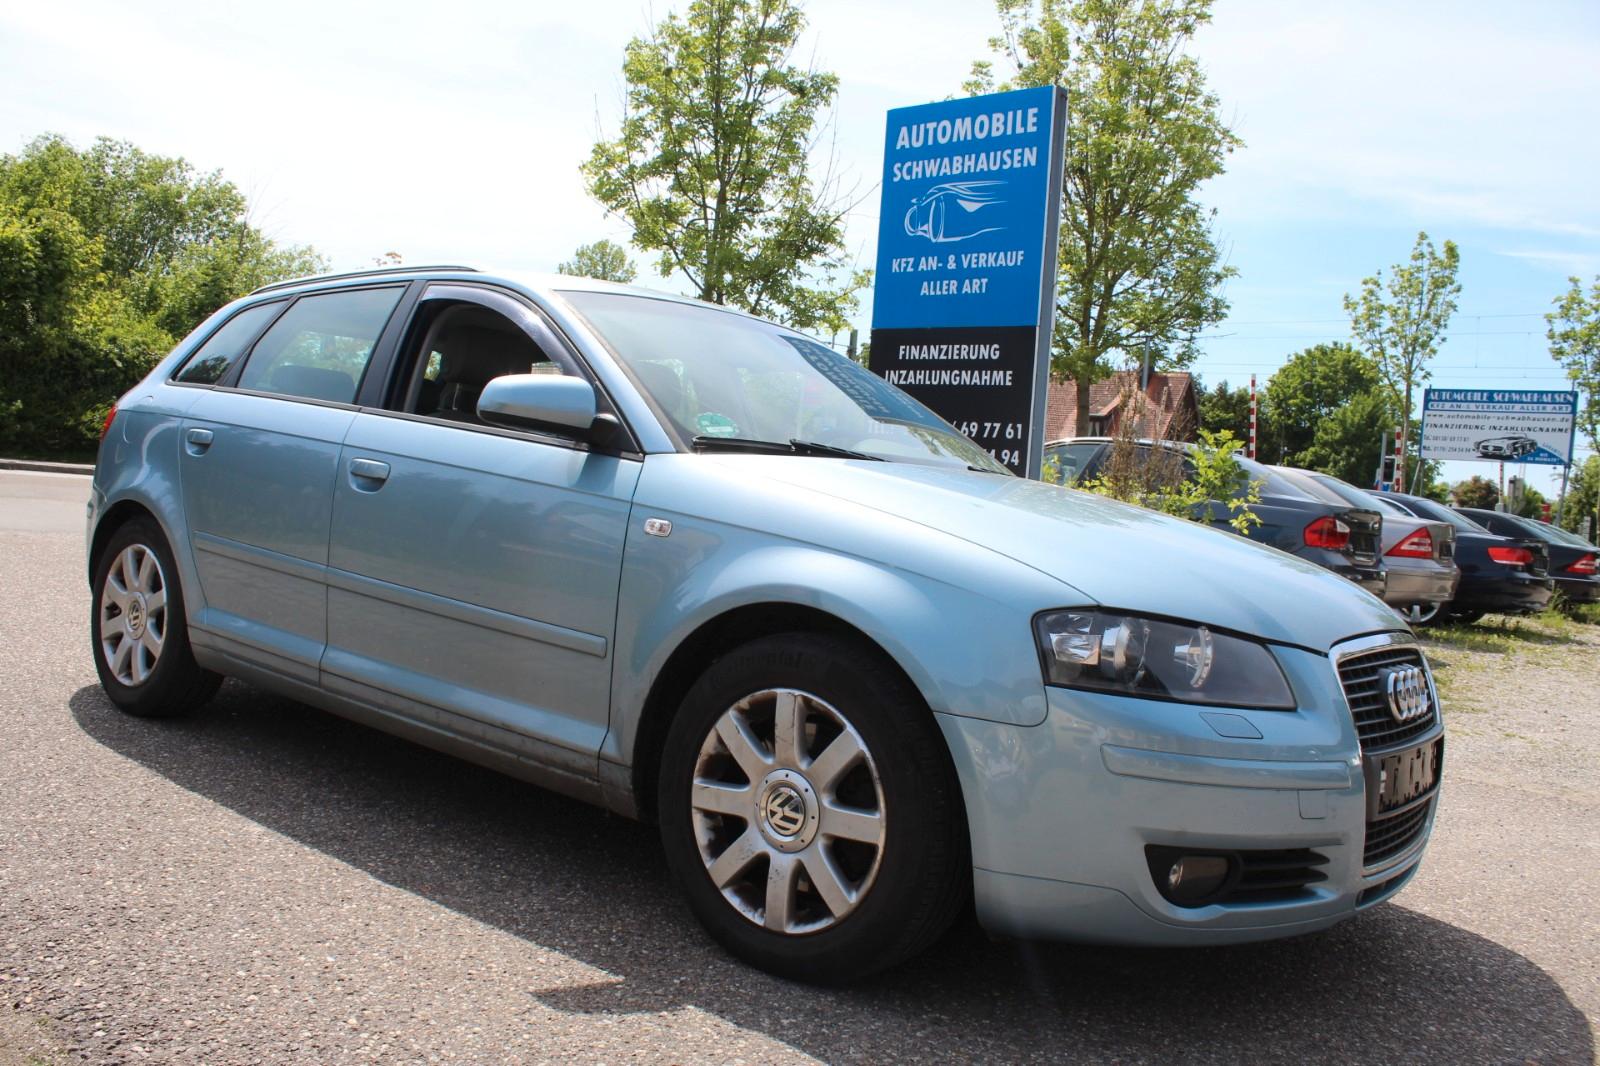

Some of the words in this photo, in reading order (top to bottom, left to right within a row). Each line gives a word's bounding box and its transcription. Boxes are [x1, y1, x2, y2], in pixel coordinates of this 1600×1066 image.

[895, 107, 1039, 150] AUTOMOBILE
[892, 146, 1038, 182] SCHWABHAUSEN
[892, 257, 915, 273] KFZ
[918, 256, 943, 272] AN-
[947, 256, 957, 270] &
[961, 250, 1025, 268] VERKAUF
[920, 280, 958, 296] ALLER
[962, 278, 988, 293] ART
[898, 343, 1001, 360] FINANZIERUNG
[884, 369, 1013, 386] INZAHLUNGNAHME
[1427, 391, 1489, 401] AUTOMOBILE
[960, 421, 979, 438] 69
[983, 422, 1001, 439] 77
[1005, 423, 1023, 440] 61
[1488, 424, 1569, 433] INZAHLUNGNAHME
[1001, 449, 1020, 466] 94
